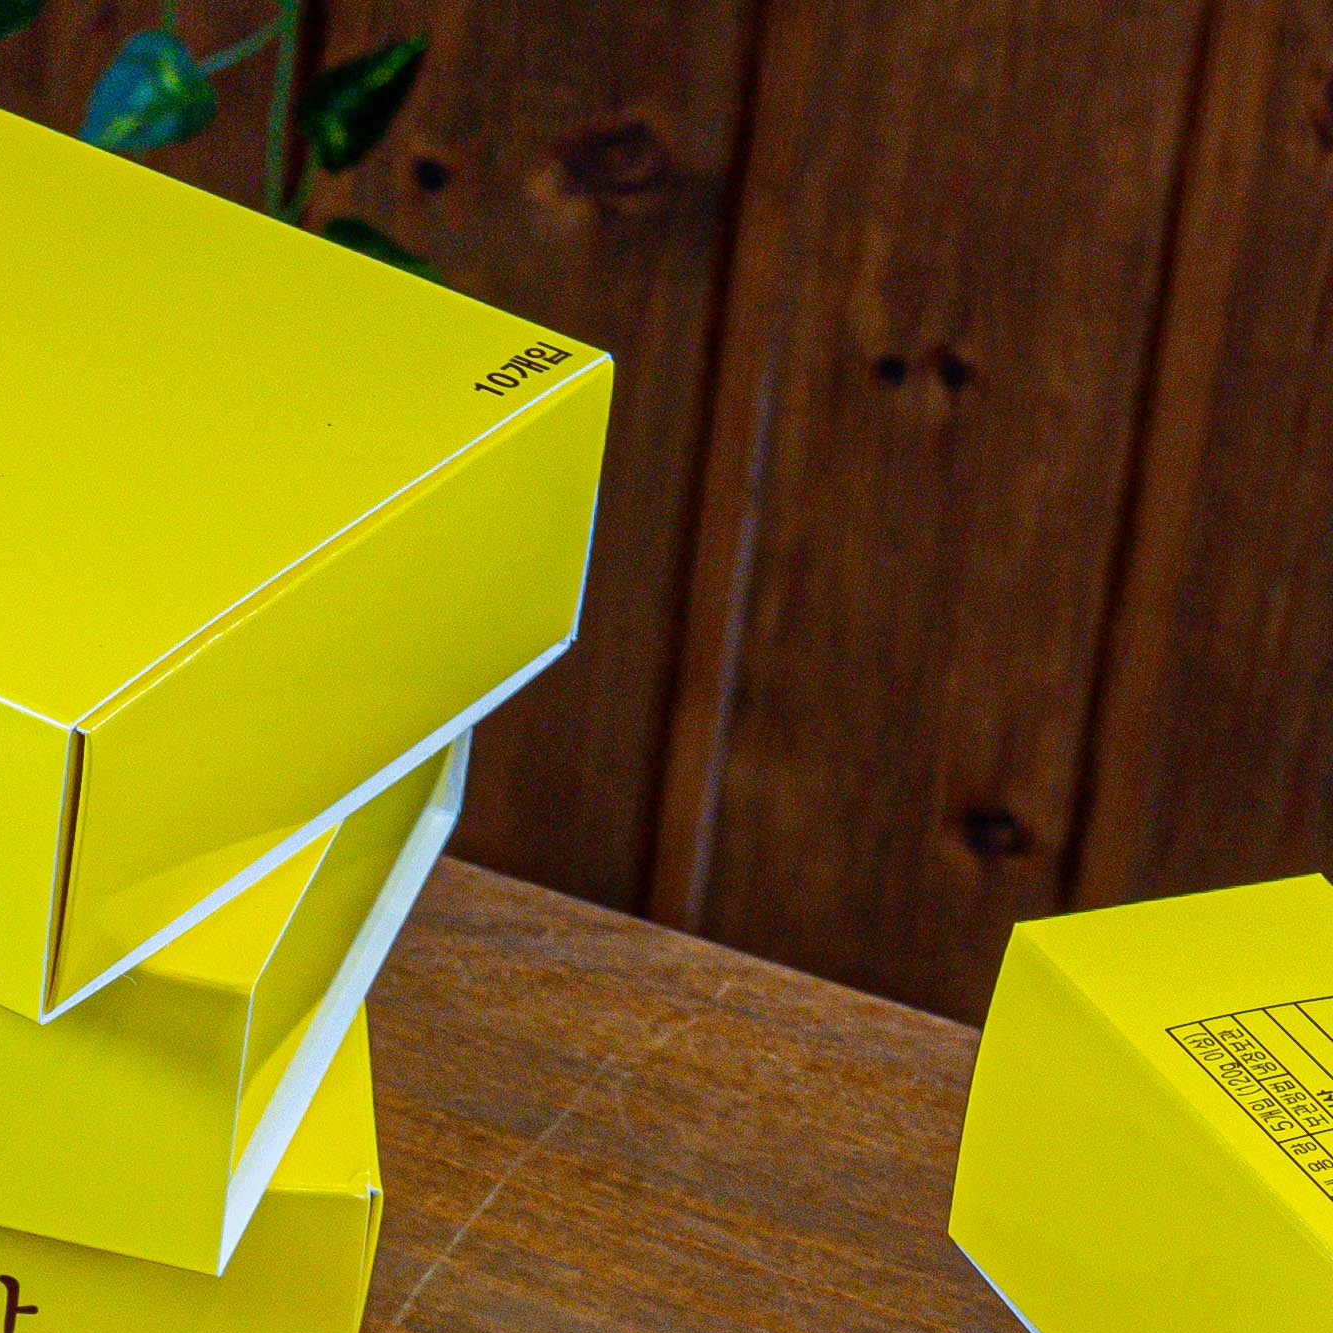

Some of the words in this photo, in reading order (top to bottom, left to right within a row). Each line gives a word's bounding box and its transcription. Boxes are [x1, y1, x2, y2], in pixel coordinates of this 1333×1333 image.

[474, 341, 573, 396] 10개입
[1218, 1029, 1277, 1075] 냉장보관
[1248, 1098, 1294, 1131] 5개입
[1269, 1080, 1333, 1127] 보관방법
